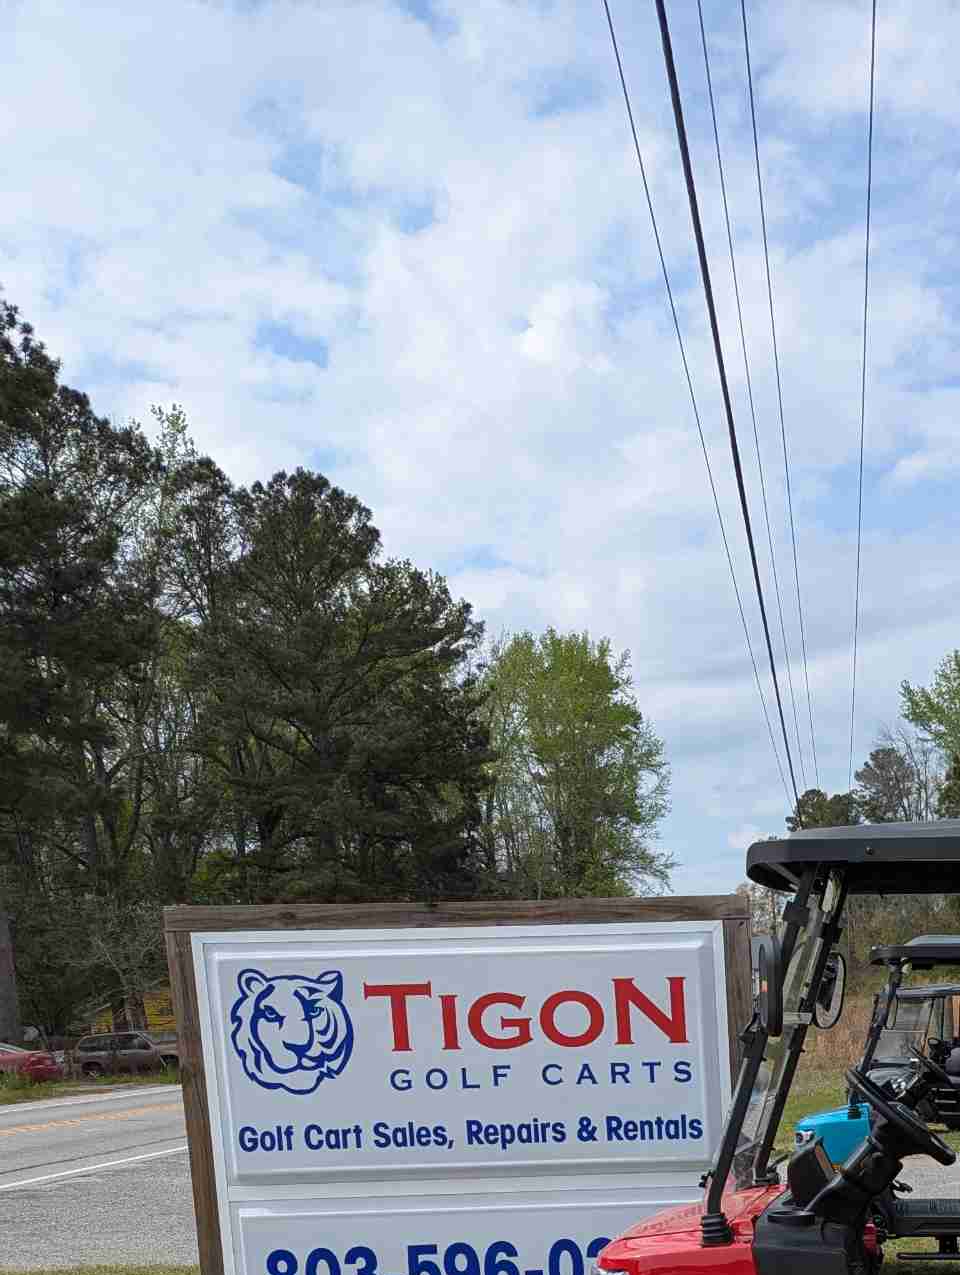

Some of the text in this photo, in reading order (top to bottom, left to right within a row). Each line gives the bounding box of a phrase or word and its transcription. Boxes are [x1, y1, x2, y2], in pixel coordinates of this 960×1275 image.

[363, 976, 691, 1052] TIGON
[389, 1060, 694, 1091] GOLF CARTS
[238, 1113, 704, 1153] Golf Cart Sales, Repairs & Rentals
